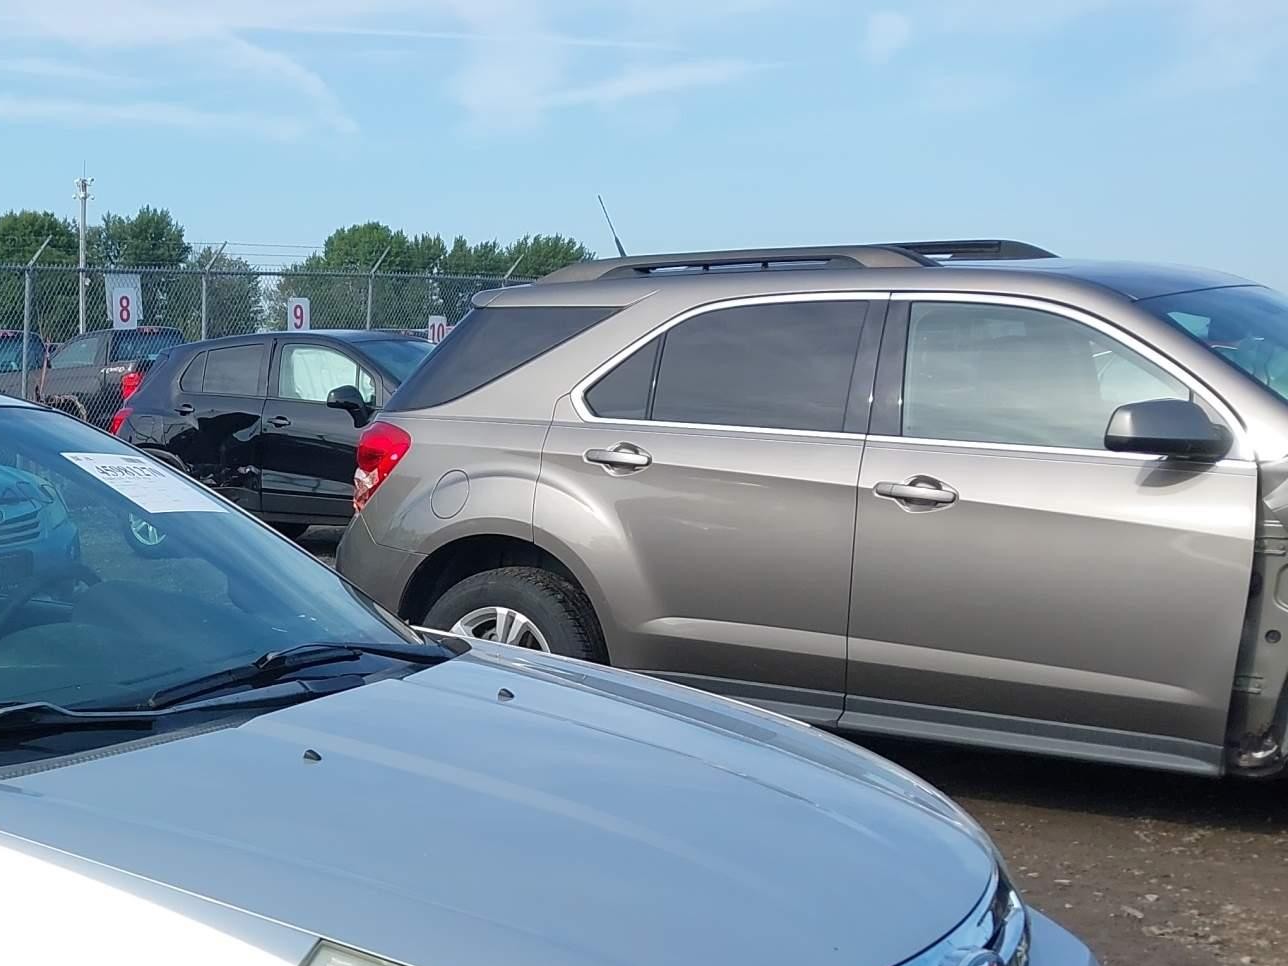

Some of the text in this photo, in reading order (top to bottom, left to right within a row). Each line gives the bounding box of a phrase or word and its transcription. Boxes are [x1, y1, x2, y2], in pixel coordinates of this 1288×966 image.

[119, 296, 130, 322] 8
[293, 304, 304, 329] 9
[430, 323, 445, 343] 10
